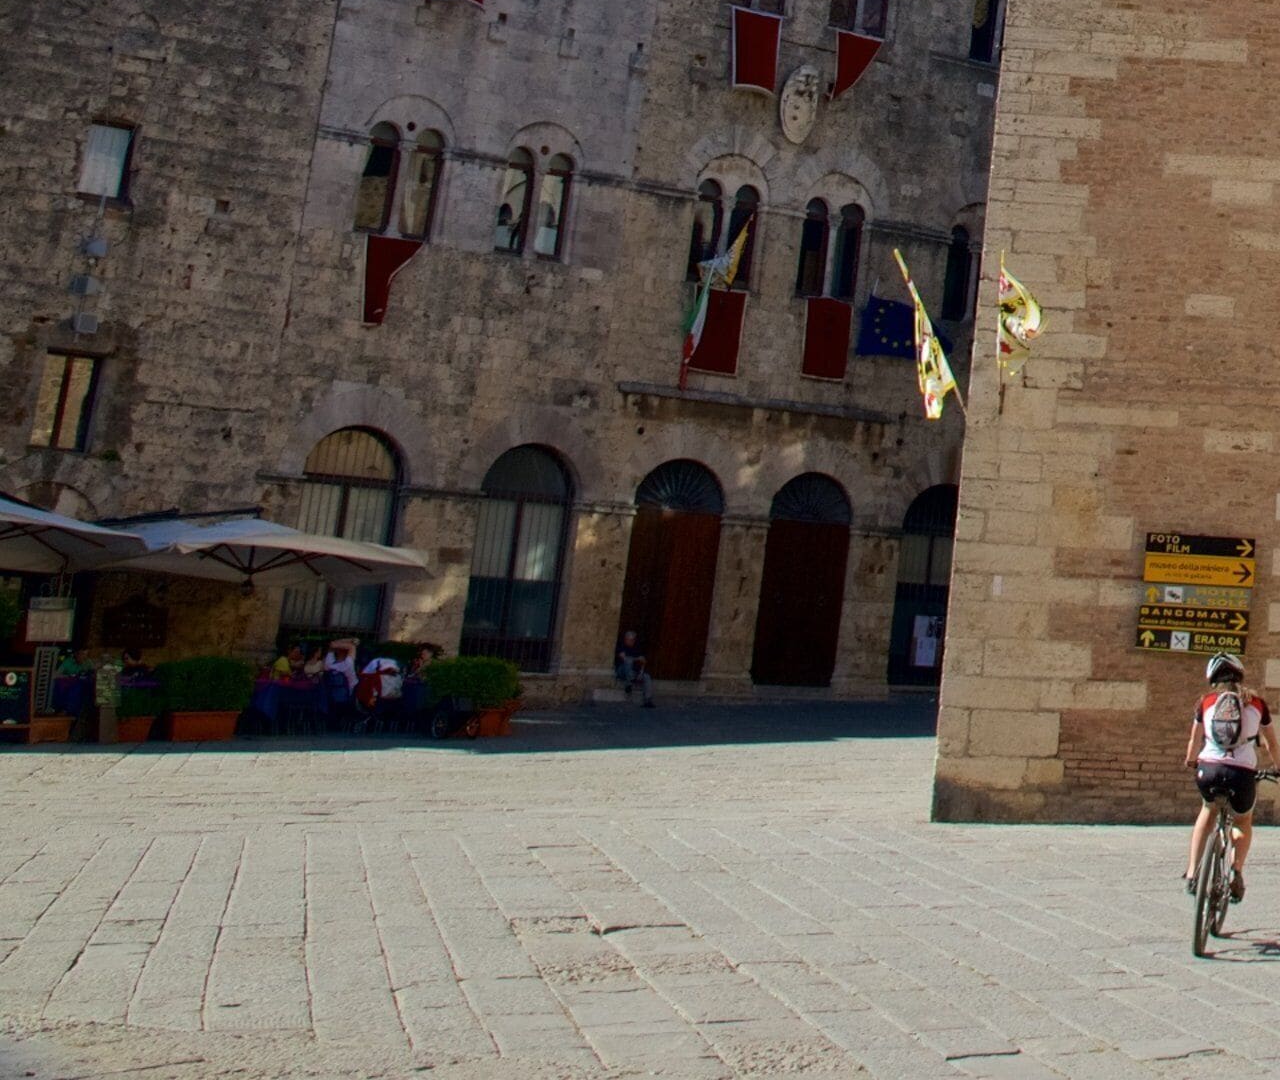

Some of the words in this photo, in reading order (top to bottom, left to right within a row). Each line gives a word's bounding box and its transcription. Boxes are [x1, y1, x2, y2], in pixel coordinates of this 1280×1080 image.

[1150, 534, 1180, 544] FOTO
[1166, 544, 1190, 553] FILM
[1149, 562, 1177, 570] museo
[1206, 599, 1248, 608] SOLE
[1140, 607, 1227, 619] BANCOMAT
[1194, 634, 1216, 645] ERA
[1218, 636, 1241, 647] ORA
